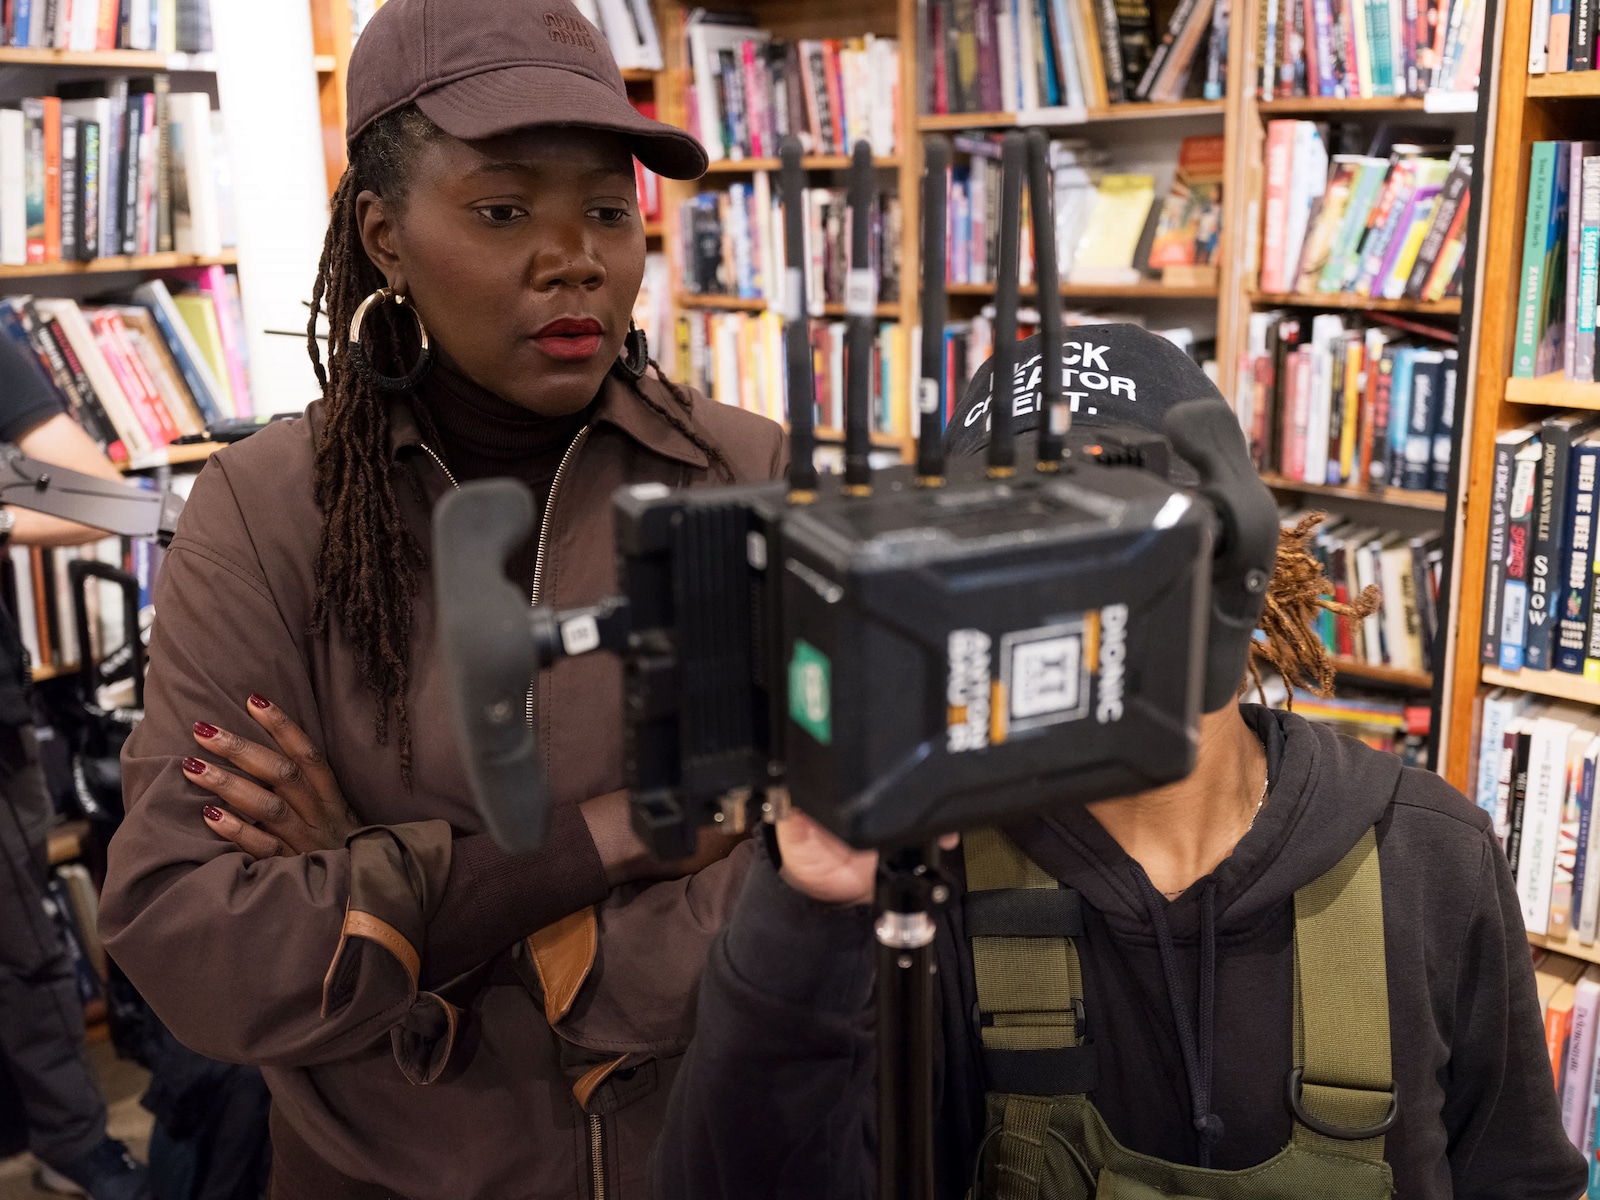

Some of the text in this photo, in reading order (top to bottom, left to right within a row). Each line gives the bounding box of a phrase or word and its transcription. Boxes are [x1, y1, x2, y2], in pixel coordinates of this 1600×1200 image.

[1583, 231, 1598, 268] SECOND
[1580, 269, 1596, 328] FOUNDATION
[1495, 465, 1509, 502] EDGE
[1538, 442, 1557, 542] JOHN BANVILLE
[1489, 513, 1506, 561] WATER
[1569, 455, 1596, 590] WHEN WE WERE BIRDS
[1554, 821, 1581, 884] YARA
